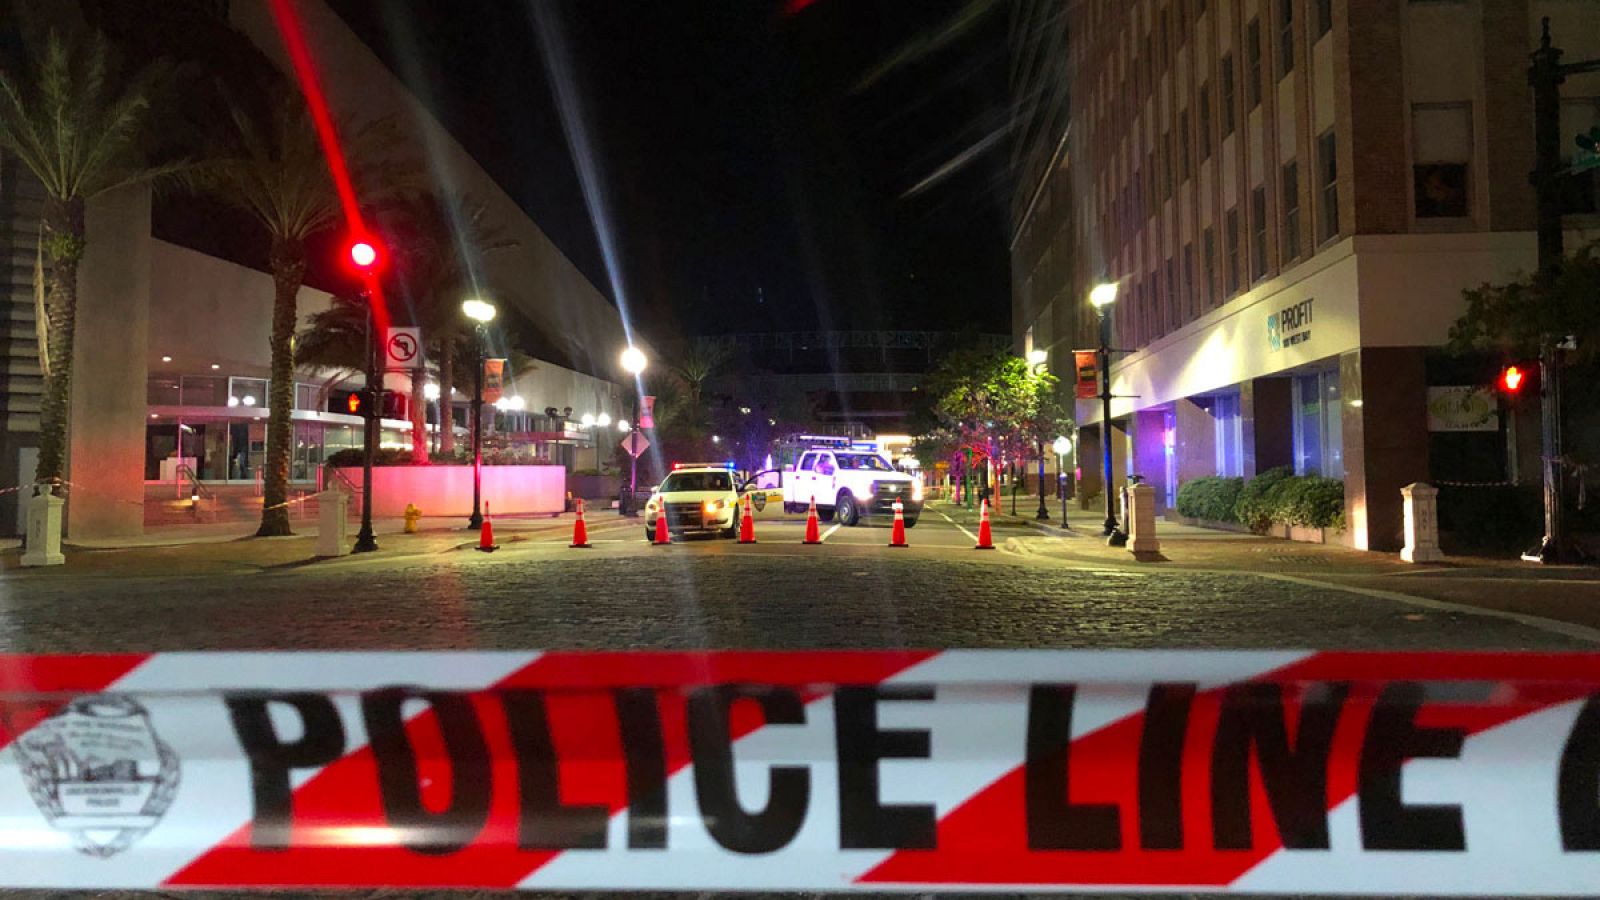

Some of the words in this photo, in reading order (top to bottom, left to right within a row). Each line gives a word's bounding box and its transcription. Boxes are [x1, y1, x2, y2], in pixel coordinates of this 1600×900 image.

[1281, 297, 1314, 333] PROFIT
[223, 683, 937, 855] POLICE
[1024, 681, 1493, 852] LINE
